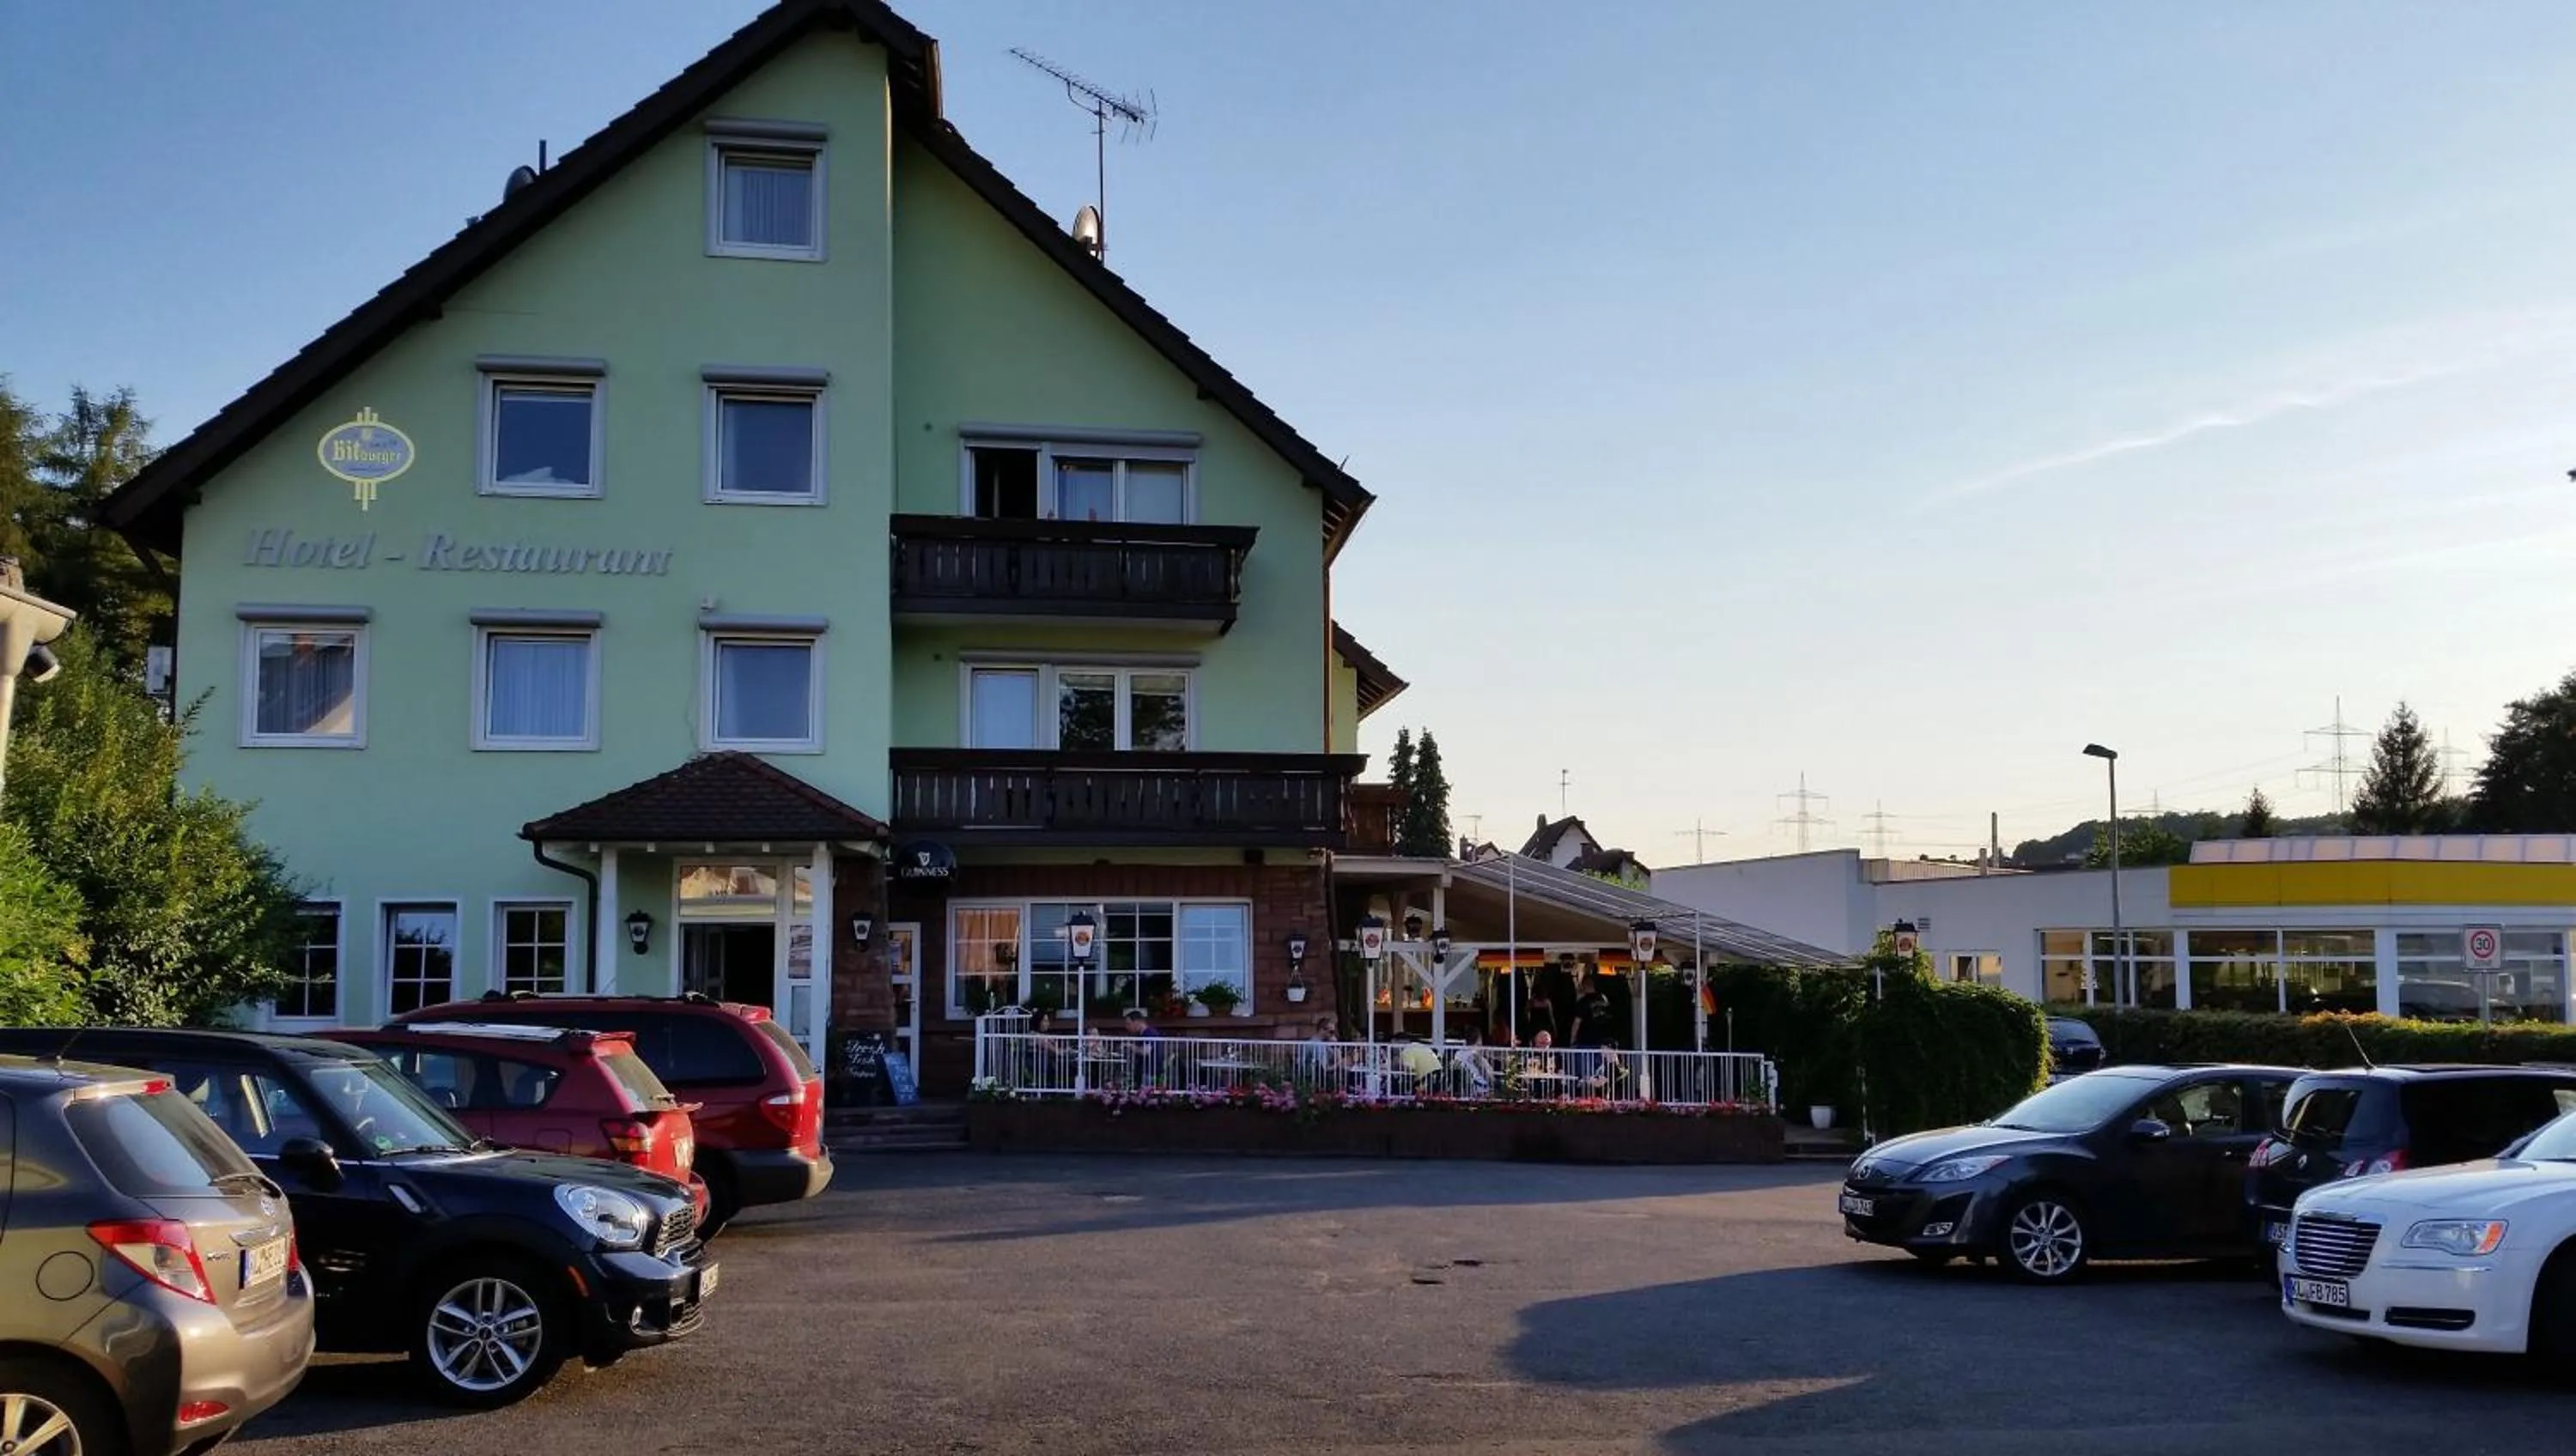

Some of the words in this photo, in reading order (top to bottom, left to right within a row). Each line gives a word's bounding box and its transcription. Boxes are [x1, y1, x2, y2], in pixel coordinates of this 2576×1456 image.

[243, 528, 376, 568] Hotel
[418, 531, 673, 576] Restaurant
[2476, 937, 2491, 950] 30
